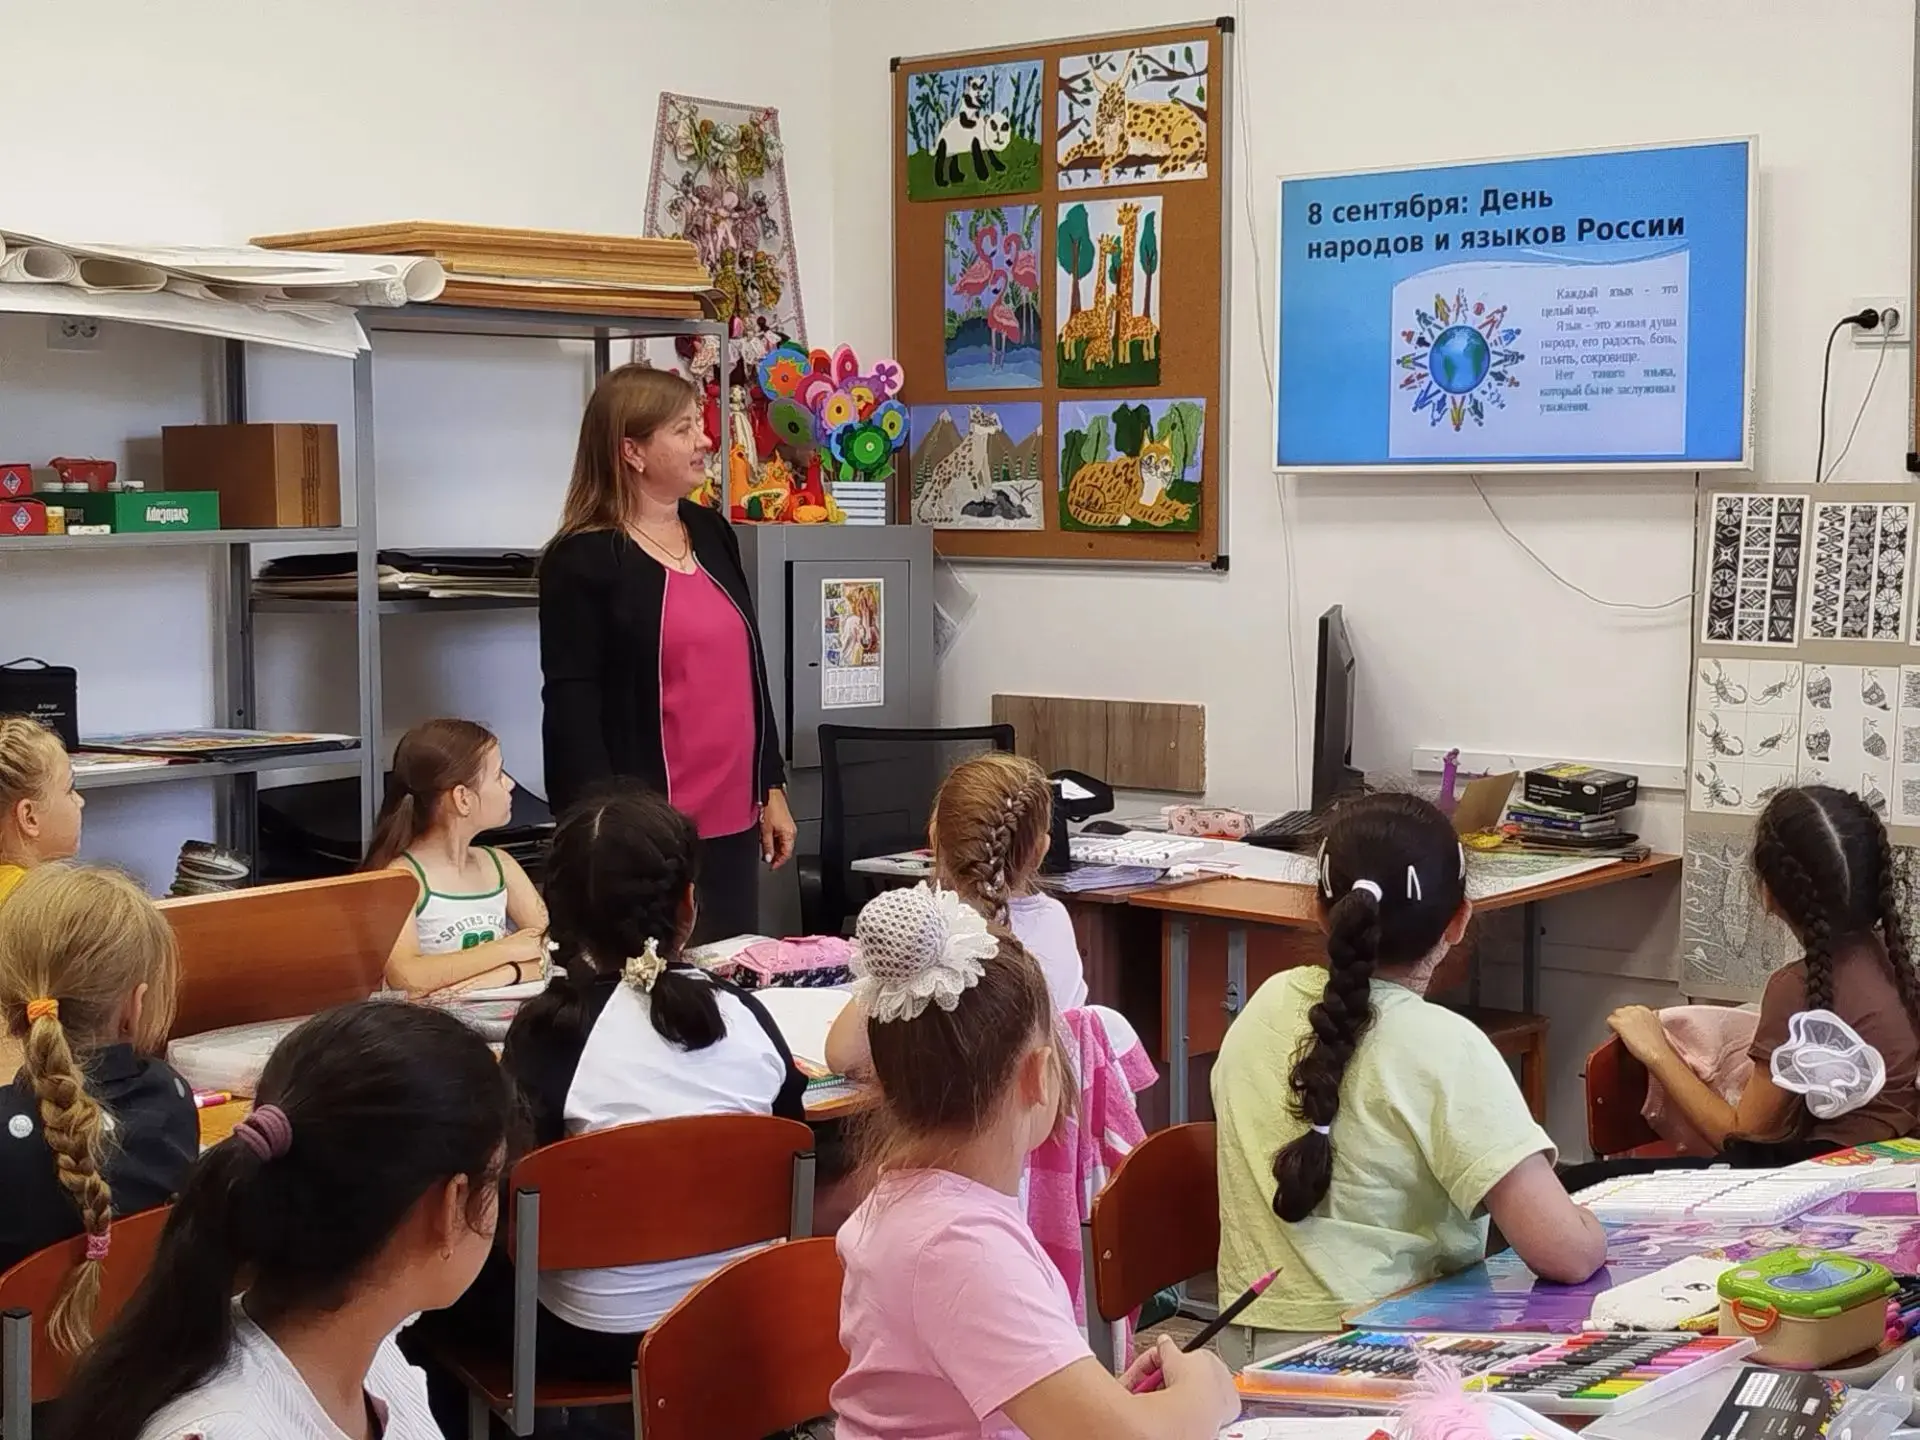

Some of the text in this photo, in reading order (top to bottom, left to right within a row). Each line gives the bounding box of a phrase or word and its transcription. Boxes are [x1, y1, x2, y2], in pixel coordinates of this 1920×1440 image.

[1308, 188, 1553, 225] 8 сентября: День
[1308, 217, 1685, 263] народов и языков России
[1556, 286, 1598, 300] Каждый
[1609, 287, 1634, 297] язык
[1661, 285, 1679, 295] это
[1541, 304, 1599, 318] целый мир.
[1556, 321, 1582, 332] Язык
[1594, 320, 1611, 330] это
[1615, 318, 1646, 329] живая
[1649, 318, 1677, 331] душа
[1540, 332, 1677, 351] народа, его радость, боль,
[1540, 352, 1640, 366] память, сокровище.
[1555, 370, 1575, 380] Нет
[1539, 384, 1582, 399] который
[1584, 384, 1599, 396] бы
[1601, 386, 1613, 395] не
[146, 506, 189, 525] SvetoCopy
[440, 916, 484, 941] SPOTRS
